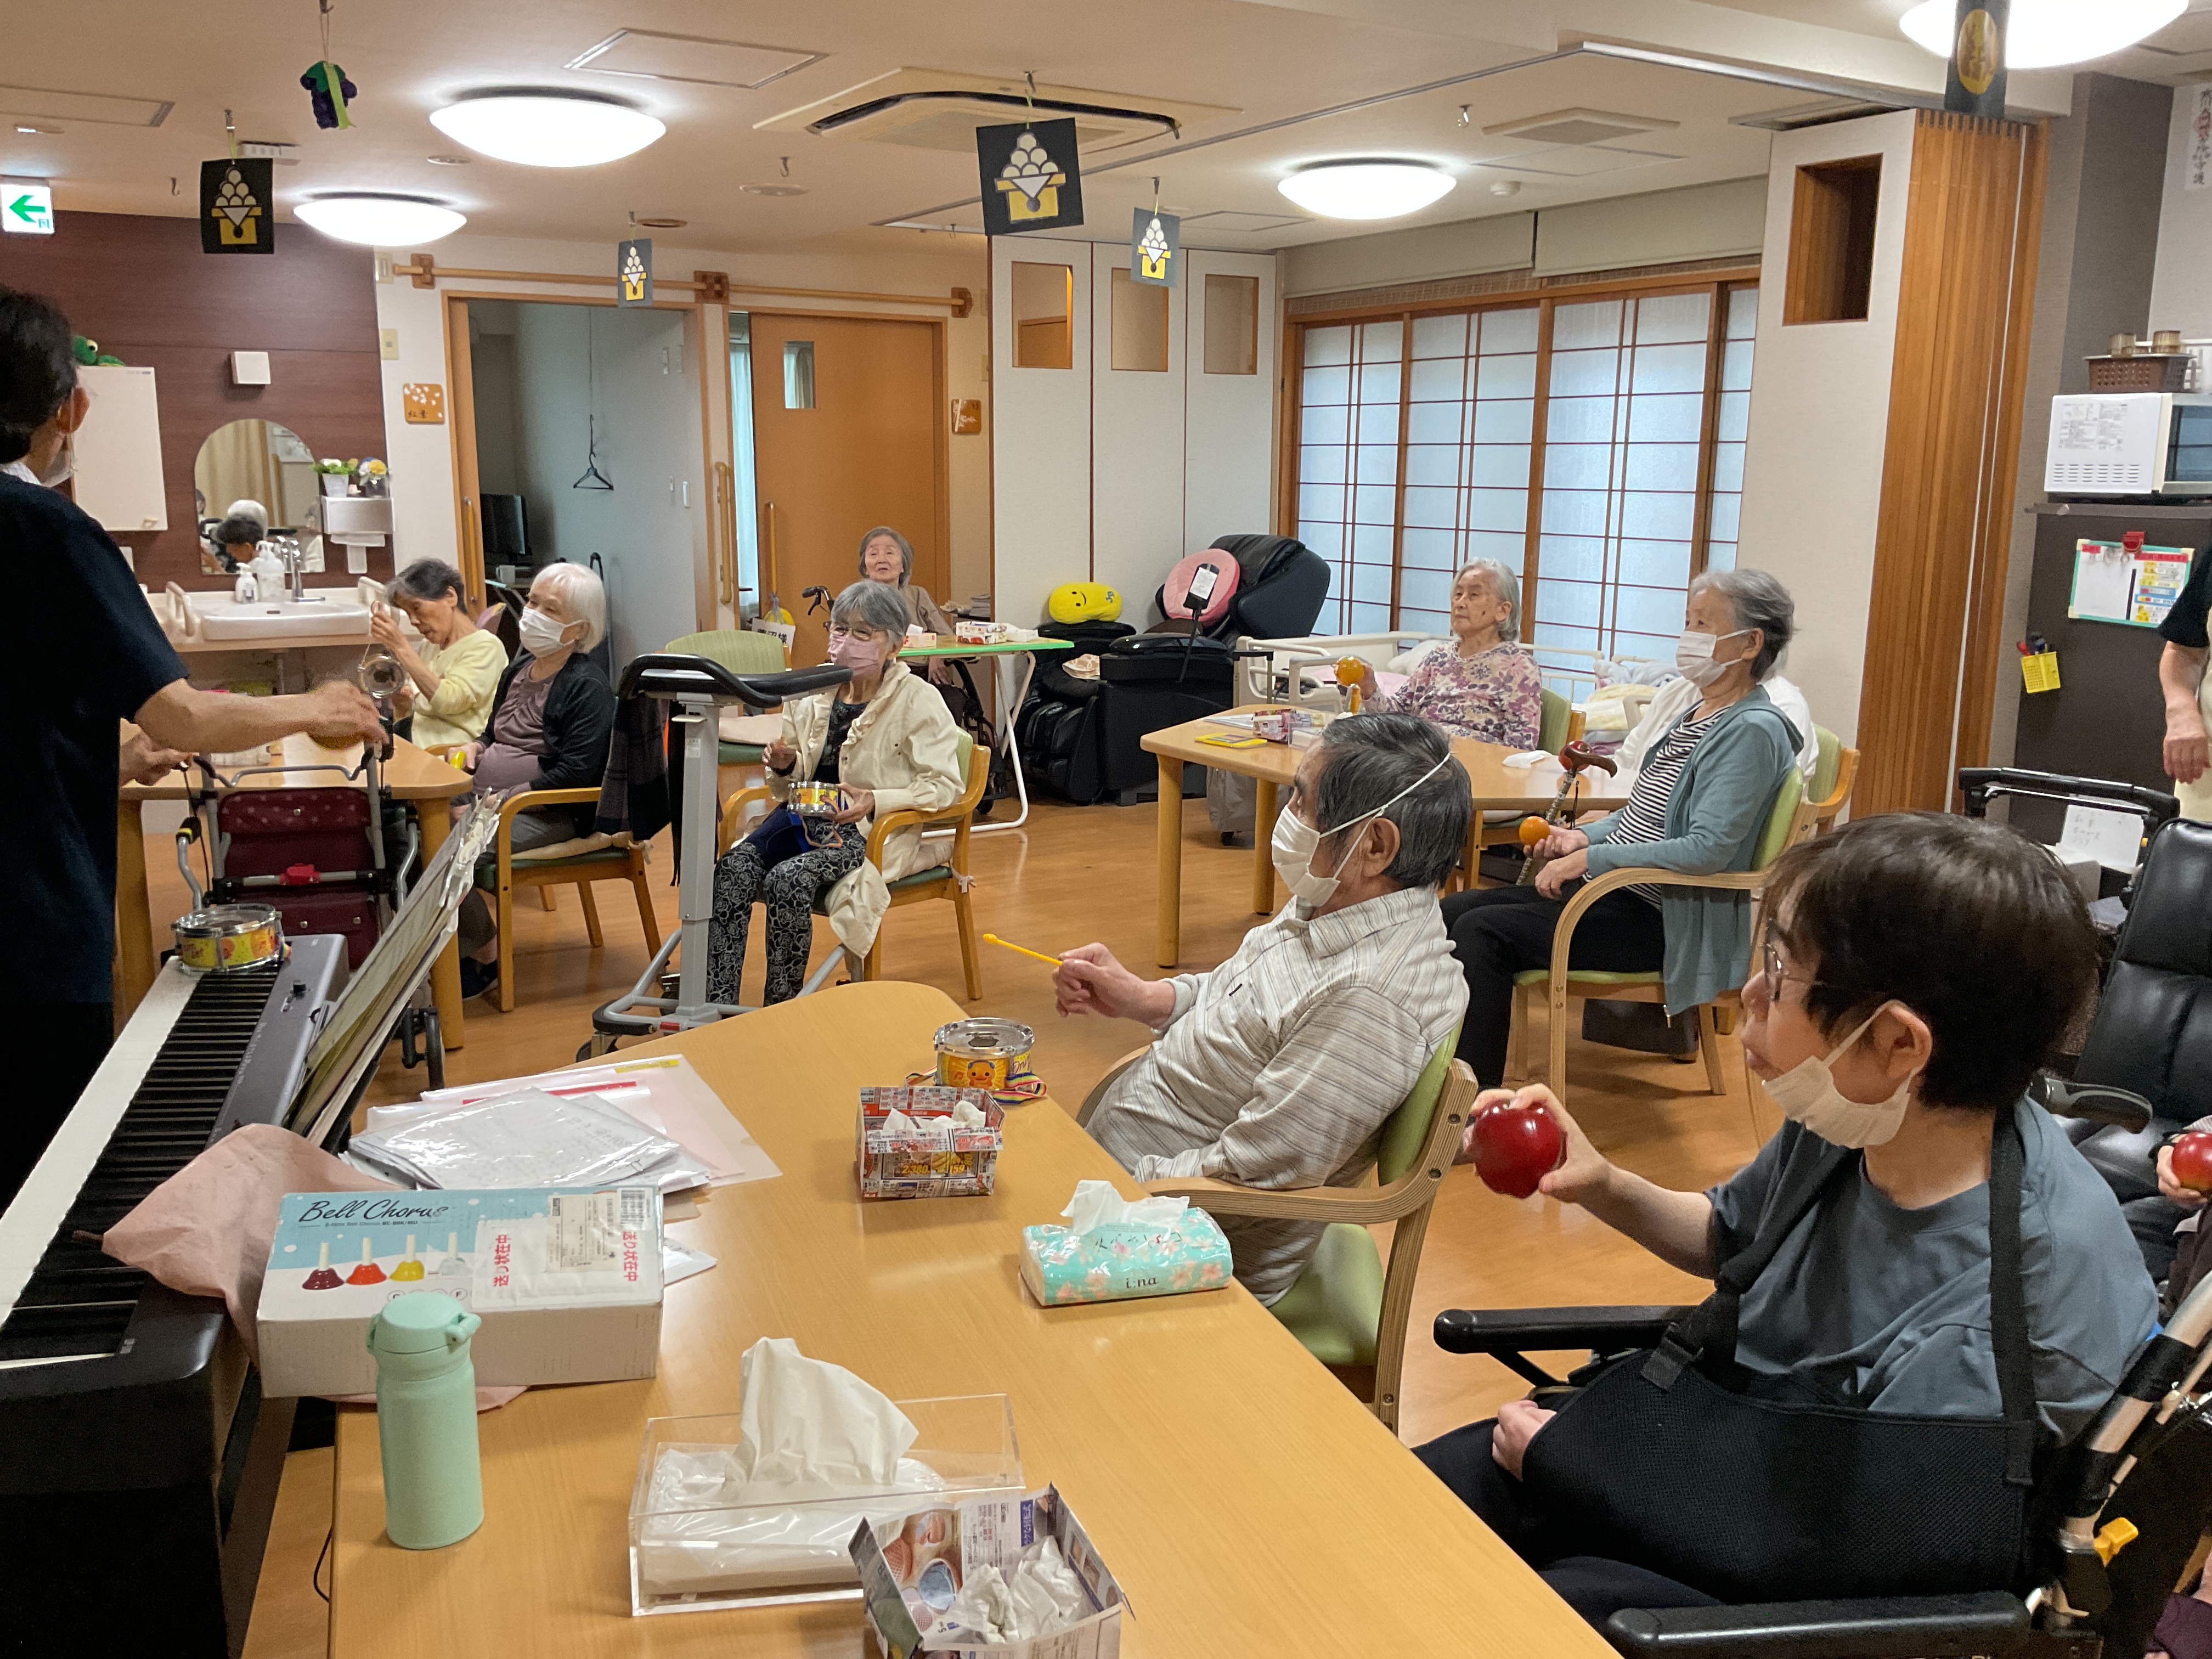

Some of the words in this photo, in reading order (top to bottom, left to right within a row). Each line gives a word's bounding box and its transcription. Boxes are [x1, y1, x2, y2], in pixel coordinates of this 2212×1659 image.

[299, 1200, 368, 1222] Bell
[363, 1199, 449, 1220] Chorus
[493, 1234, 512, 1287] 送り状在中
[623, 1230, 639, 1282] 送り状在中
